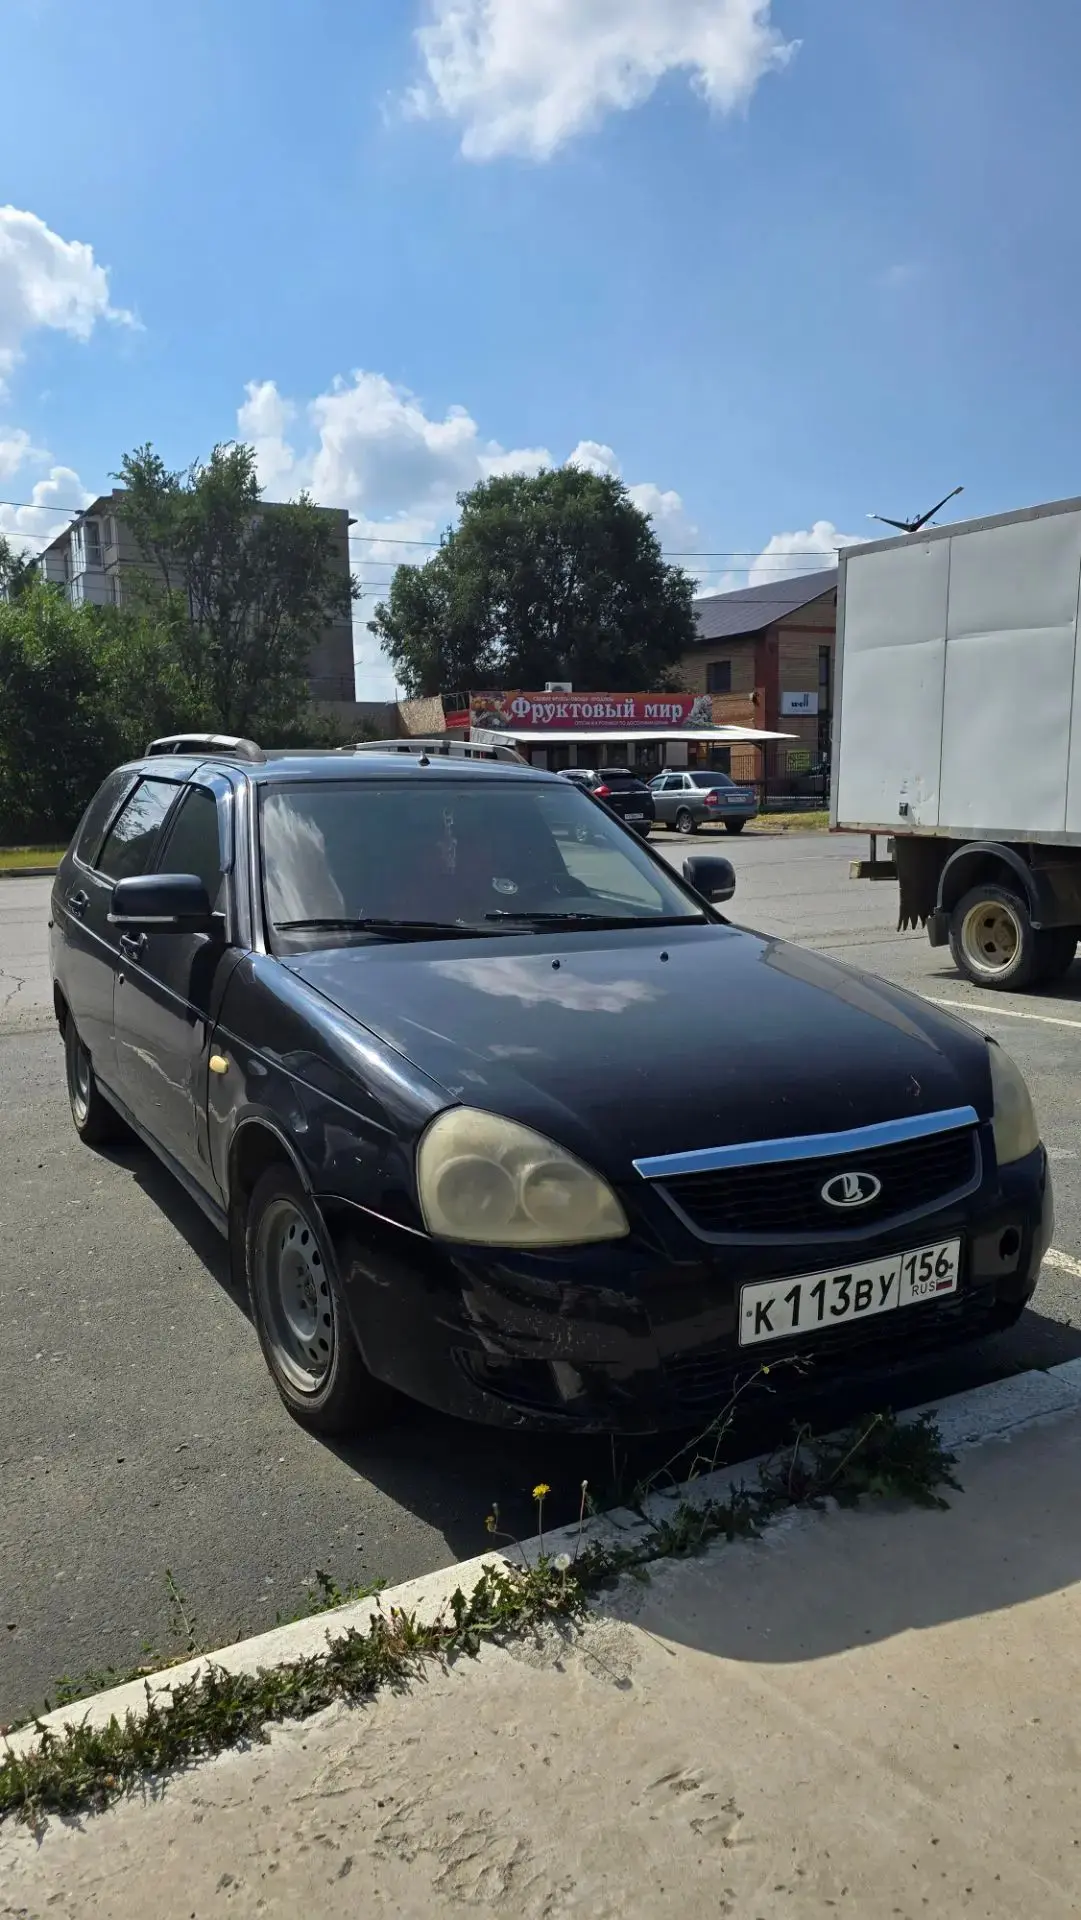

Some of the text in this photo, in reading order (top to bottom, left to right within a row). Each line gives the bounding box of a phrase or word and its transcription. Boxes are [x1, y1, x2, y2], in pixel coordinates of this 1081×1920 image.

[511, 696, 683, 724] Фруктовый мир
[905, 1247, 949, 1285] 156
[911, 1281, 936, 1297] RUS
